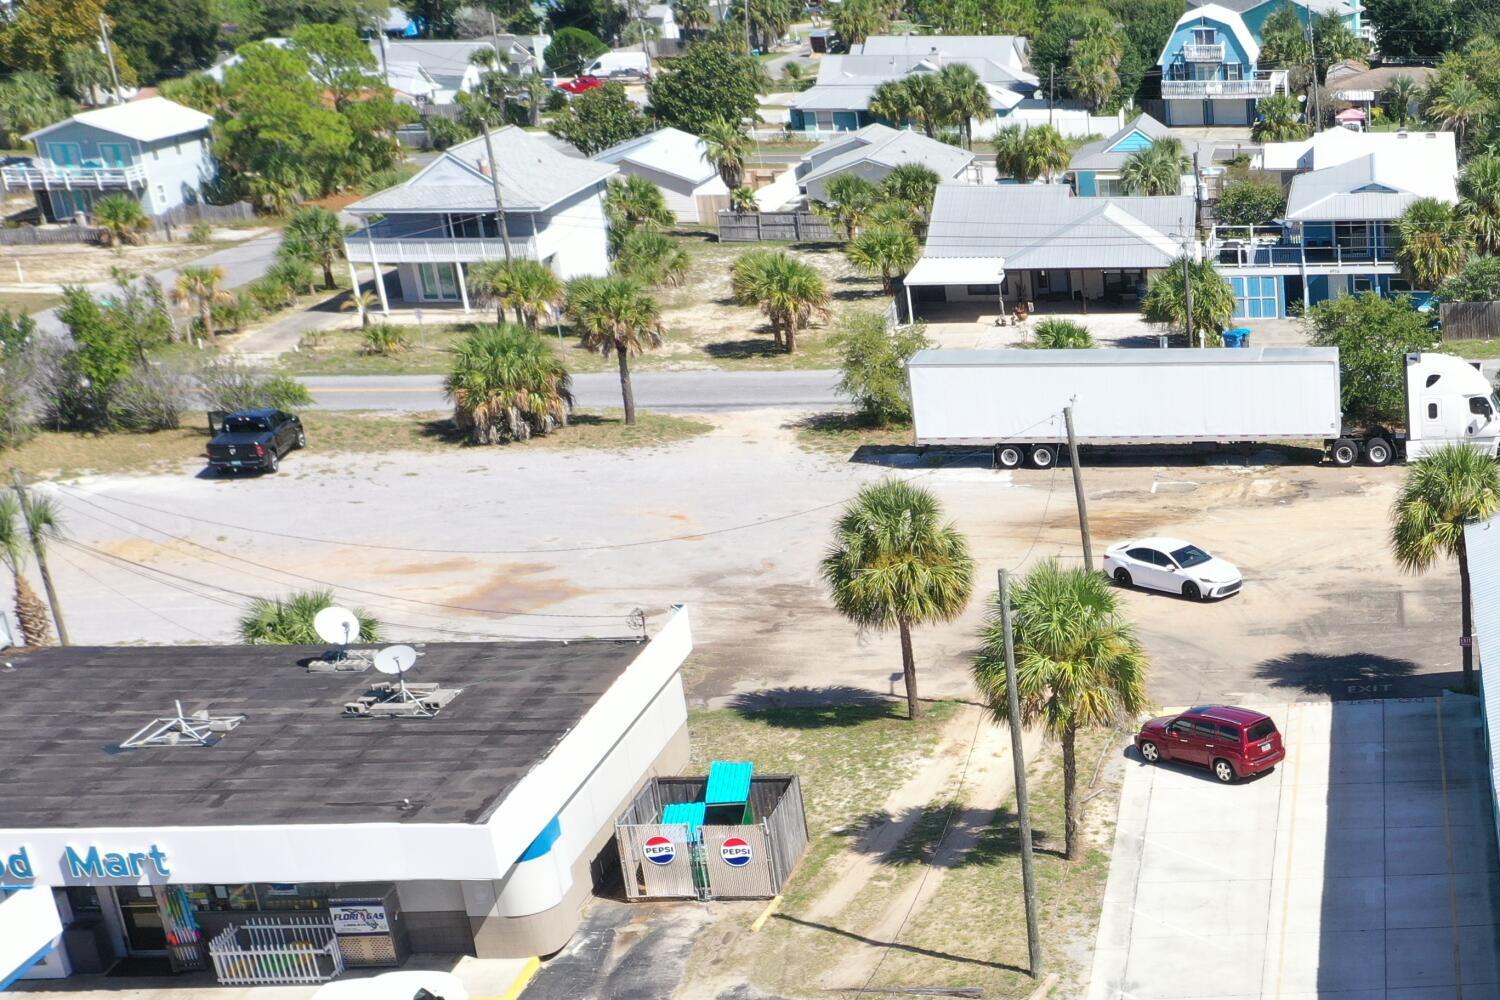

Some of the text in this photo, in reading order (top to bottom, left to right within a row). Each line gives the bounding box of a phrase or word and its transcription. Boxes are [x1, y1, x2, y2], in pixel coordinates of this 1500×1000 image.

[1347, 684, 1393, 693] EXIT
[645, 846, 674, 854] PEPSI
[65, 845, 170, 878] Mart
